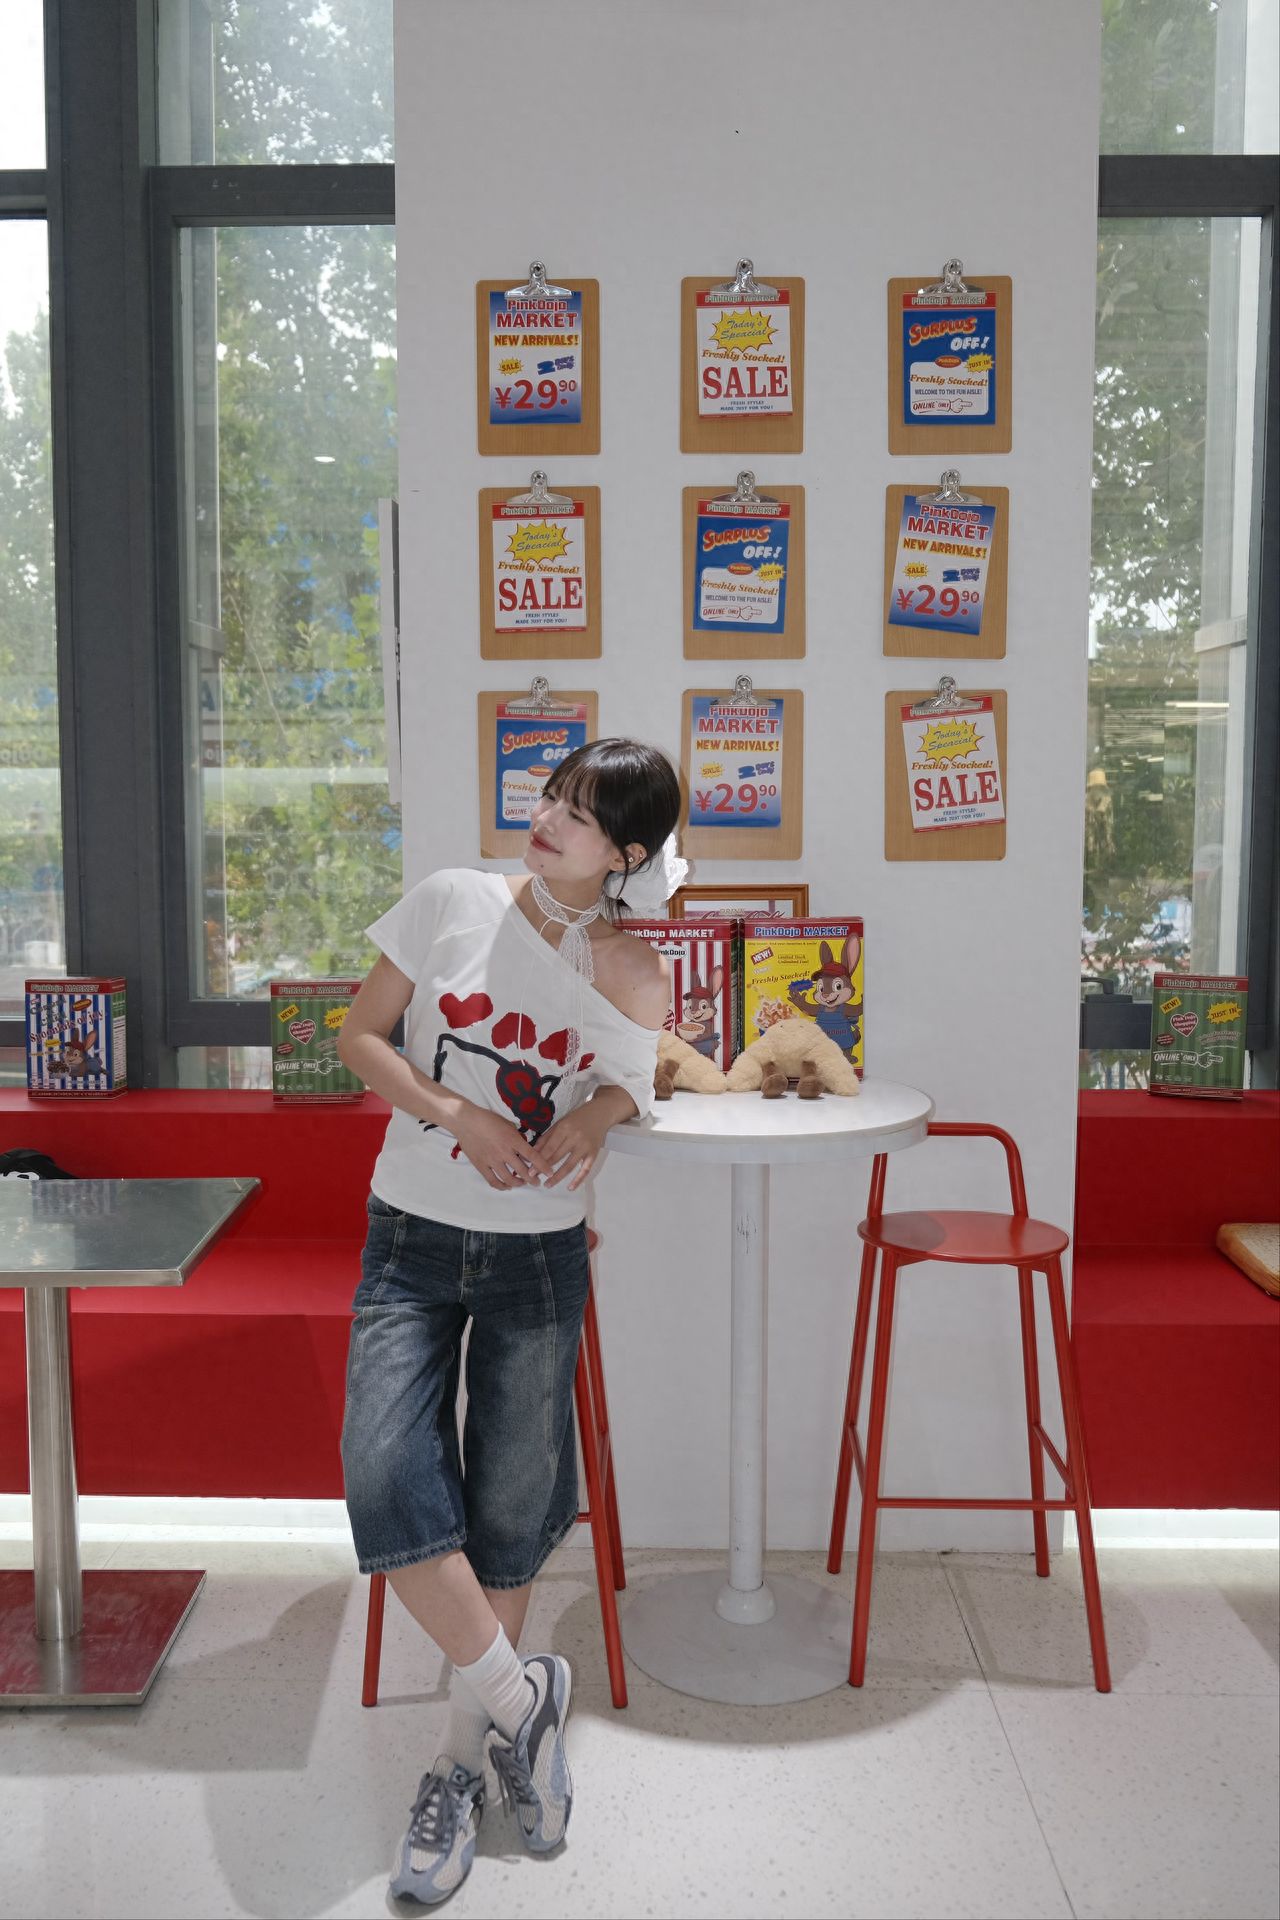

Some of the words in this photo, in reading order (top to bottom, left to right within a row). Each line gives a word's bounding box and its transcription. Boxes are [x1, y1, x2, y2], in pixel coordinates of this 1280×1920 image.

[496, 313, 578, 328] MARKET
[727, 318, 762, 329] Today's
[909, 317, 977, 346] SURPLUS
[494, 334, 520, 346] NEW
[521, 334, 579, 347] ARRIVALS!
[950, 336, 990, 351] OFF!
[702, 350, 739, 362] Freshly
[742, 352, 785, 364] Stocked!
[501, 362, 520, 372] SALE
[703, 366, 789, 400] SALE
[910, 374, 946, 386] Freshly
[947, 377, 988, 387] Stocked!
[913, 402, 935, 411] ONLINE
[920, 505, 981, 524] PinkDojo
[907, 516, 990, 541] MARKET
[522, 530, 558, 542] Today's
[703, 525, 771, 552] SURPLUS
[743, 545, 783, 559] OFF!
[903, 538, 929, 551] NEW
[930, 541, 988, 560] ARRIVALS!
[497, 561, 535, 573] Freshly
[537, 564, 580, 575] Stocked!
[907, 566, 925, 574] SALE
[498, 577, 583, 611] SALE
[702, 580, 737, 592] Freshly
[738, 584, 779, 596] Stocked!
[703, 608, 725, 616] ONLINE
[699, 718, 779, 734] MARKET
[933, 728, 968, 740] Today's
[502, 727, 569, 755] SURPLUS
[696, 739, 722, 751] NEW
[723, 740, 780, 752] ARRIVALS!
[702, 766, 720, 775] SALE
[912, 761, 949, 771] Freshly
[951, 761, 993, 770] Stocked!
[503, 781, 537, 793] Freshly
[914, 771, 999, 812] SALE
[505, 808, 528, 816] ONLINE
[669, 928, 714, 938] MARKET
[755, 927, 801, 937] PinkDojo
[803, 926, 849, 936] MARKET
[753, 949, 772, 962] NEW!
[751, 976, 779, 985] Freshly
[780, 970, 810, 980] Stocked!
[65, 984, 99, 992] MARKET
[1200, 981, 1238, 989] MARKET
[1162, 999, 1179, 1012] NEW!
[280, 1007, 296, 1020] NEW!
[328, 1015, 343, 1025] JUST
[1211, 1010, 1227, 1020] JUST
[1228, 1007, 1238, 1015] IN
[1154, 1053, 1180, 1061] ONLINE
[275, 1061, 300, 1071] ONLINE
